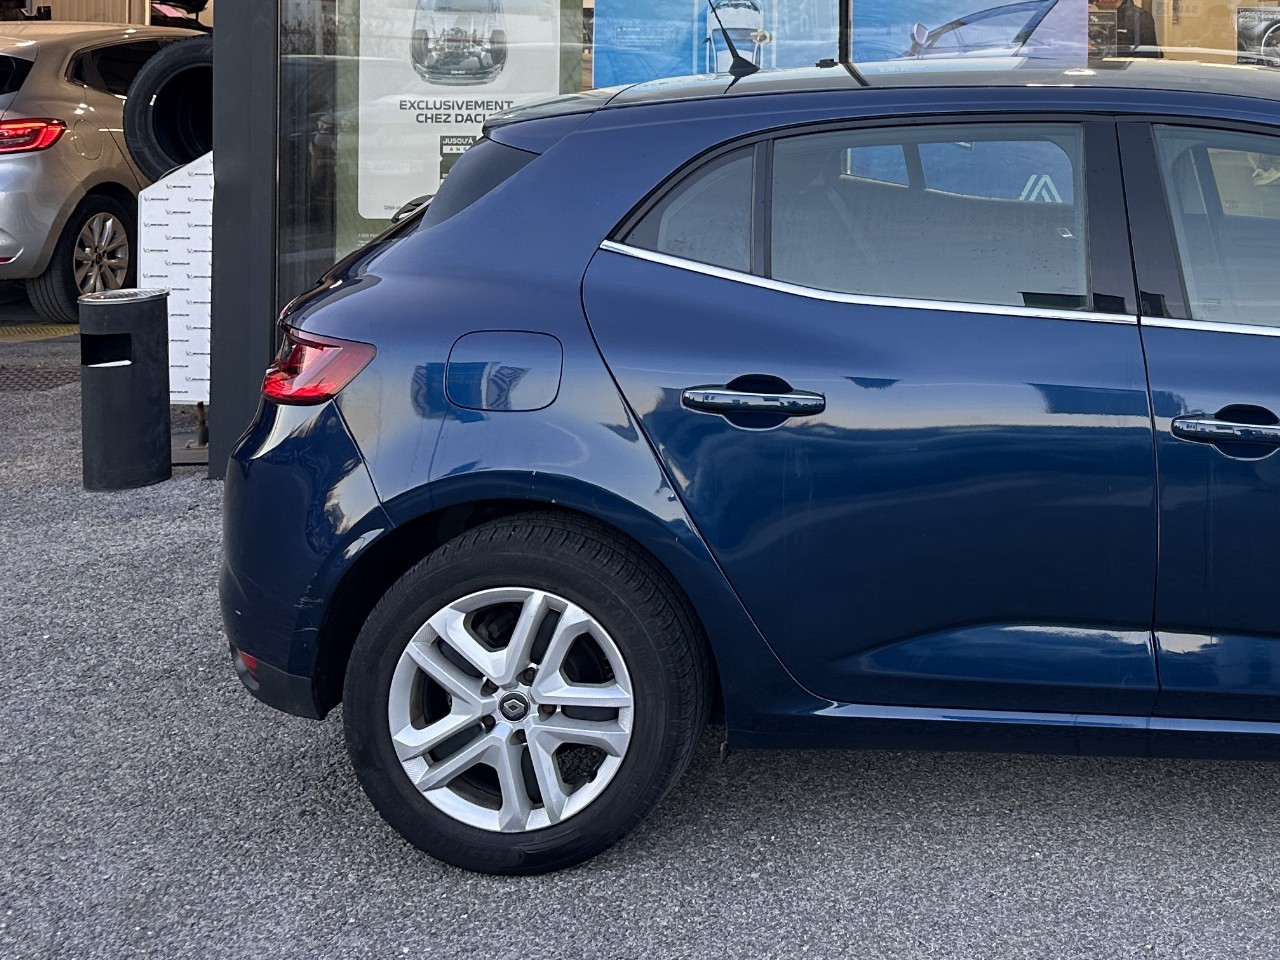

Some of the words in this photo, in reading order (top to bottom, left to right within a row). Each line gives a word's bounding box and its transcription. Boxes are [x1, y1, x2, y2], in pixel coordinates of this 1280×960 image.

[399, 100, 514, 111] EXCLUSIVEMENT
[416, 113, 452, 124] CHEZ
[454, 113, 491, 124] DACI
[442, 137, 474, 145] JUSQU'À
